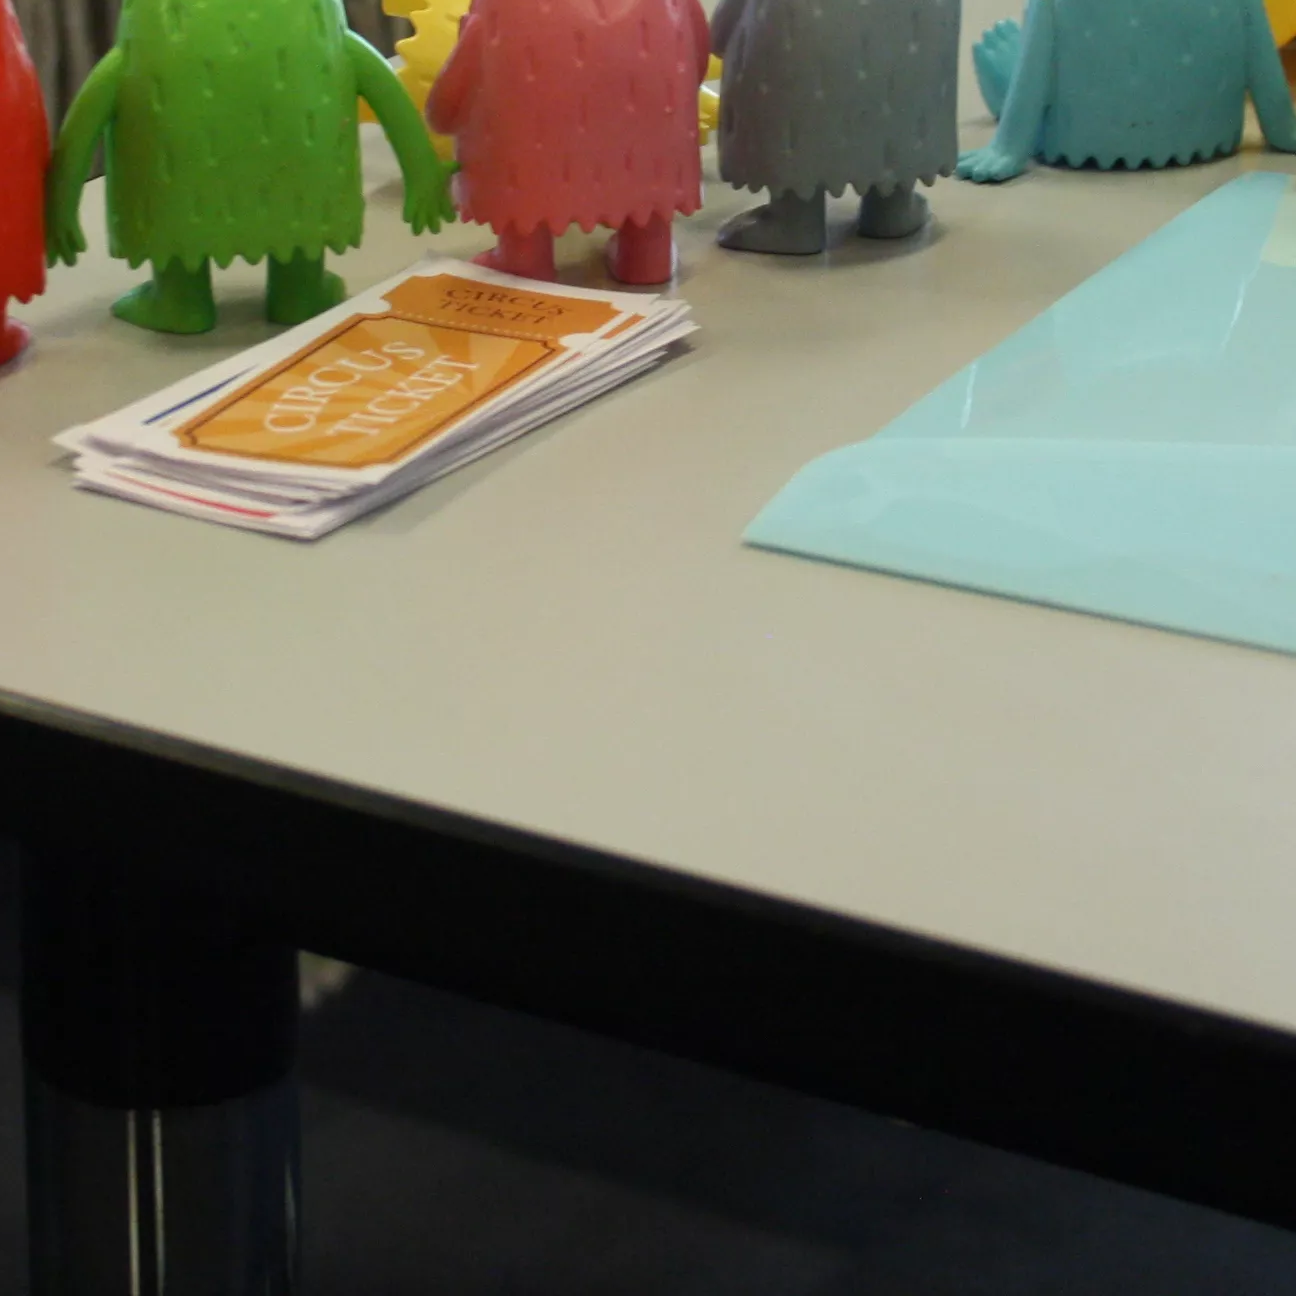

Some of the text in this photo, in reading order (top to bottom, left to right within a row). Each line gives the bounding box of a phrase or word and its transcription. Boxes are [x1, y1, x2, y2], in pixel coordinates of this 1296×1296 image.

[440, 298, 546, 324] TICKET
[444, 289, 573, 316] CIRCUS
[264, 341, 425, 434] CIRCUS
[325, 354, 480, 437] TICKET
